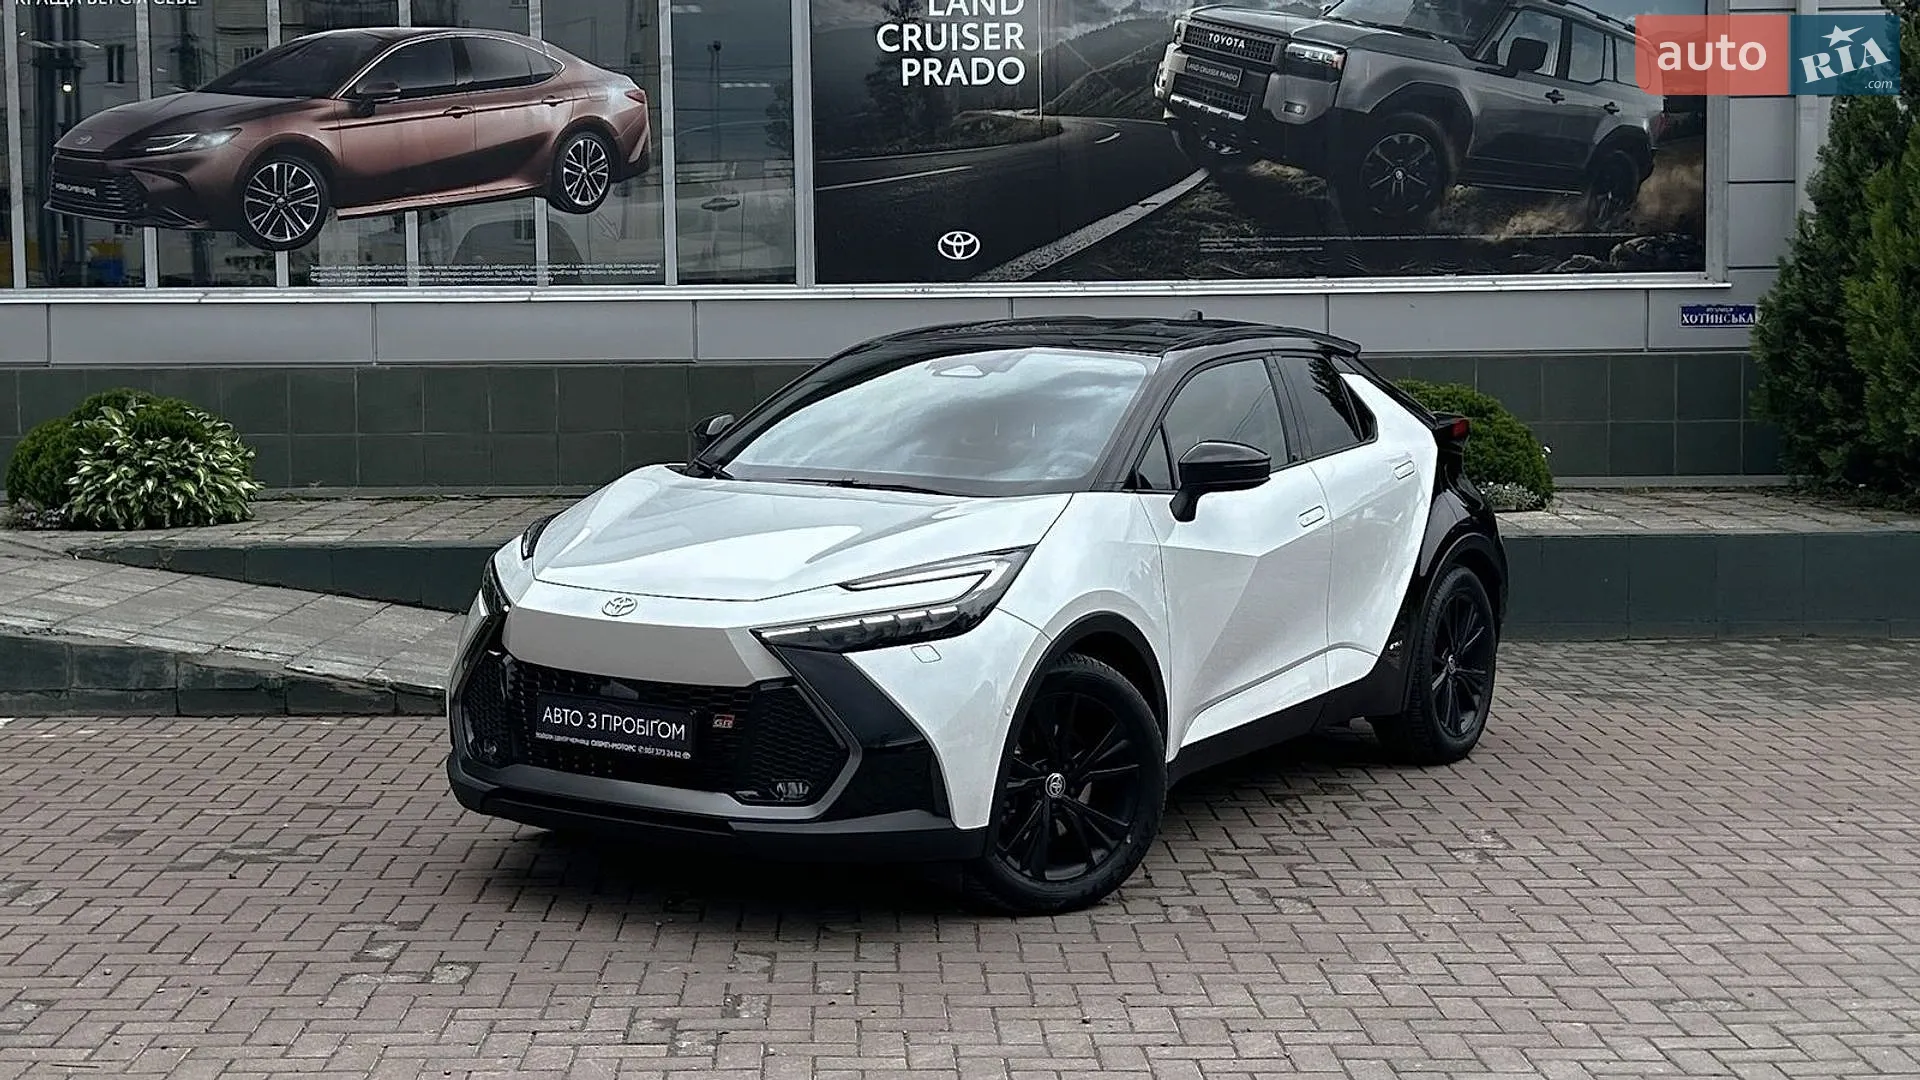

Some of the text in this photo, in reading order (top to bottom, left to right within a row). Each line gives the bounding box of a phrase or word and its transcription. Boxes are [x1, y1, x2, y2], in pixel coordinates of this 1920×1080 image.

[928, 0, 1025, 16] LAND
[876, 22, 1025, 52] CRUISER
[1208, 33, 1245, 48] TOYOTA
[901, 56, 1026, 86] PRADO
[1682, 313, 1754, 324] ХОТИНСЬКА
[542, 706, 583, 727] АВТО
